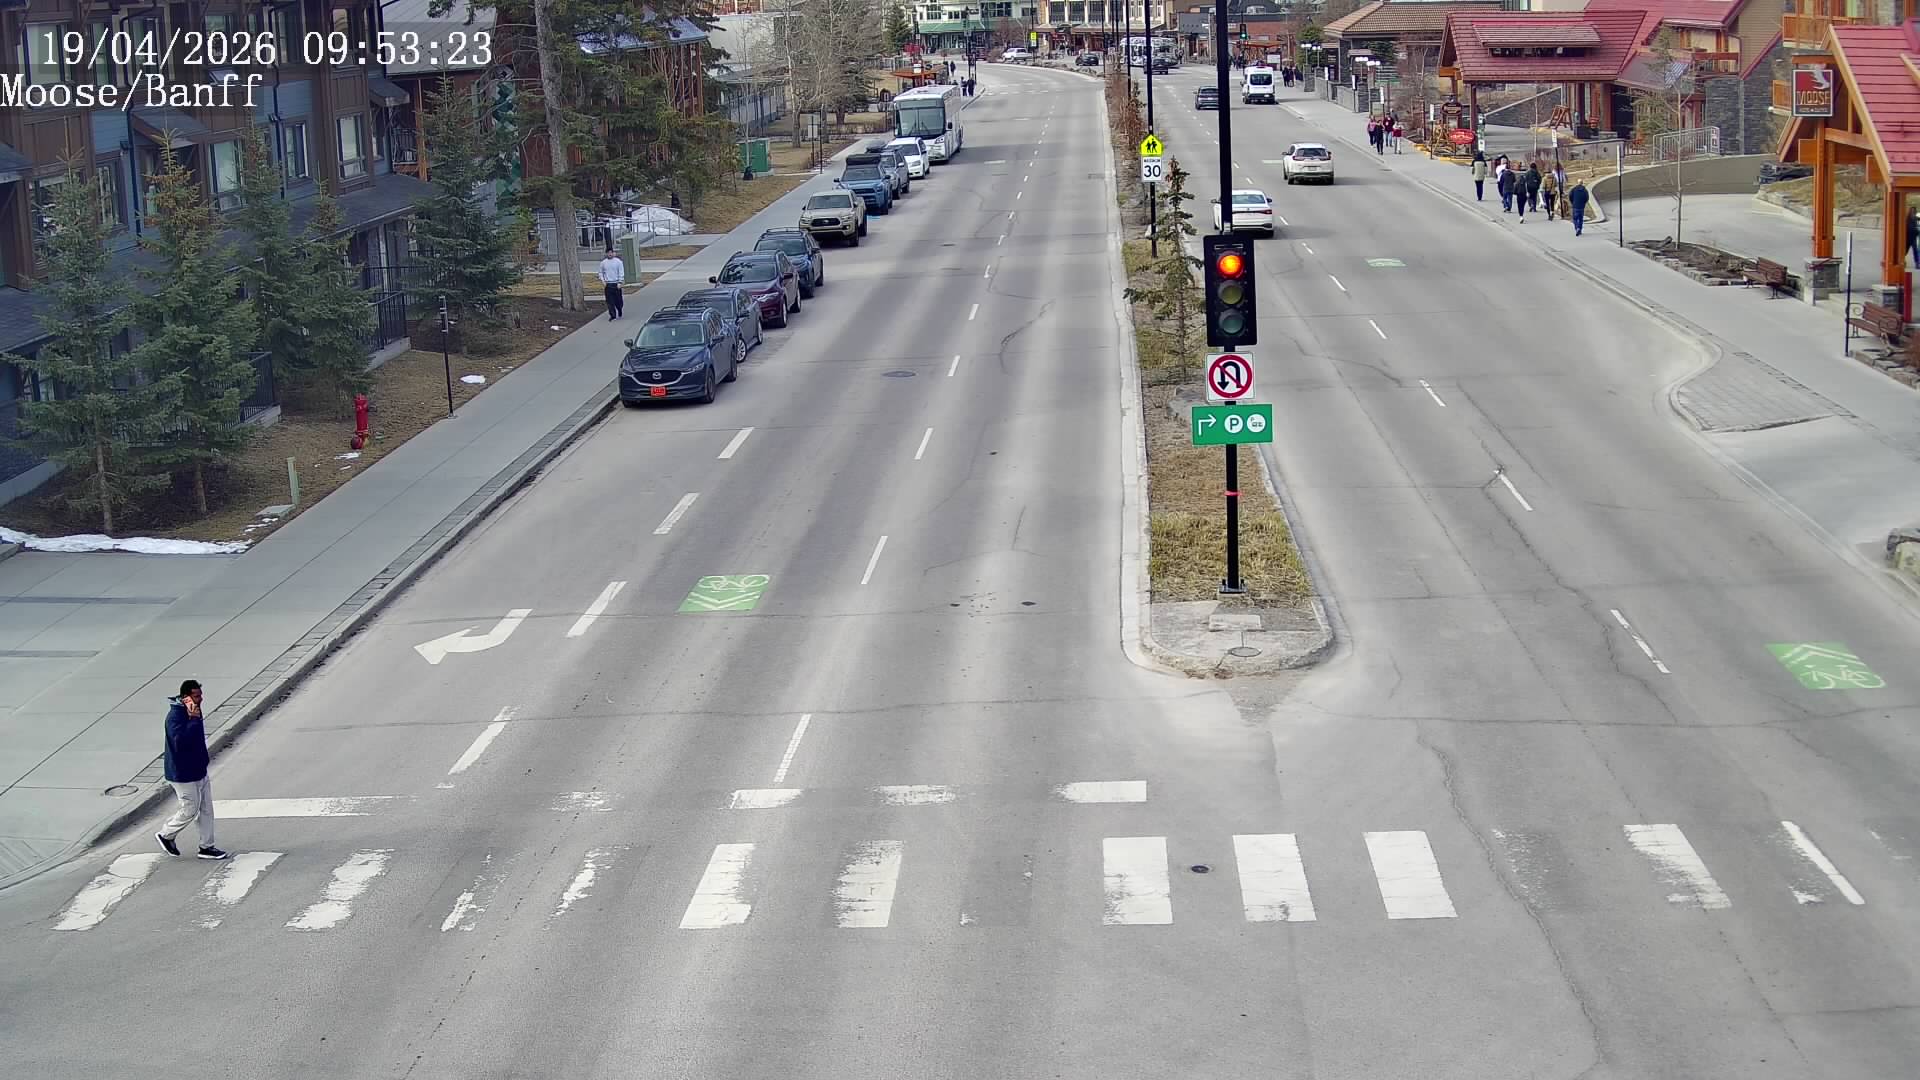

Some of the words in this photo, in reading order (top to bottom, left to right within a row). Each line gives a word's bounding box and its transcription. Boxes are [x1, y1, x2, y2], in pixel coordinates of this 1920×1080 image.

[1795, 90, 1831, 106] MOOSE
[1144, 165, 1161, 177] 30
[1229, 417, 1240, 430] P
